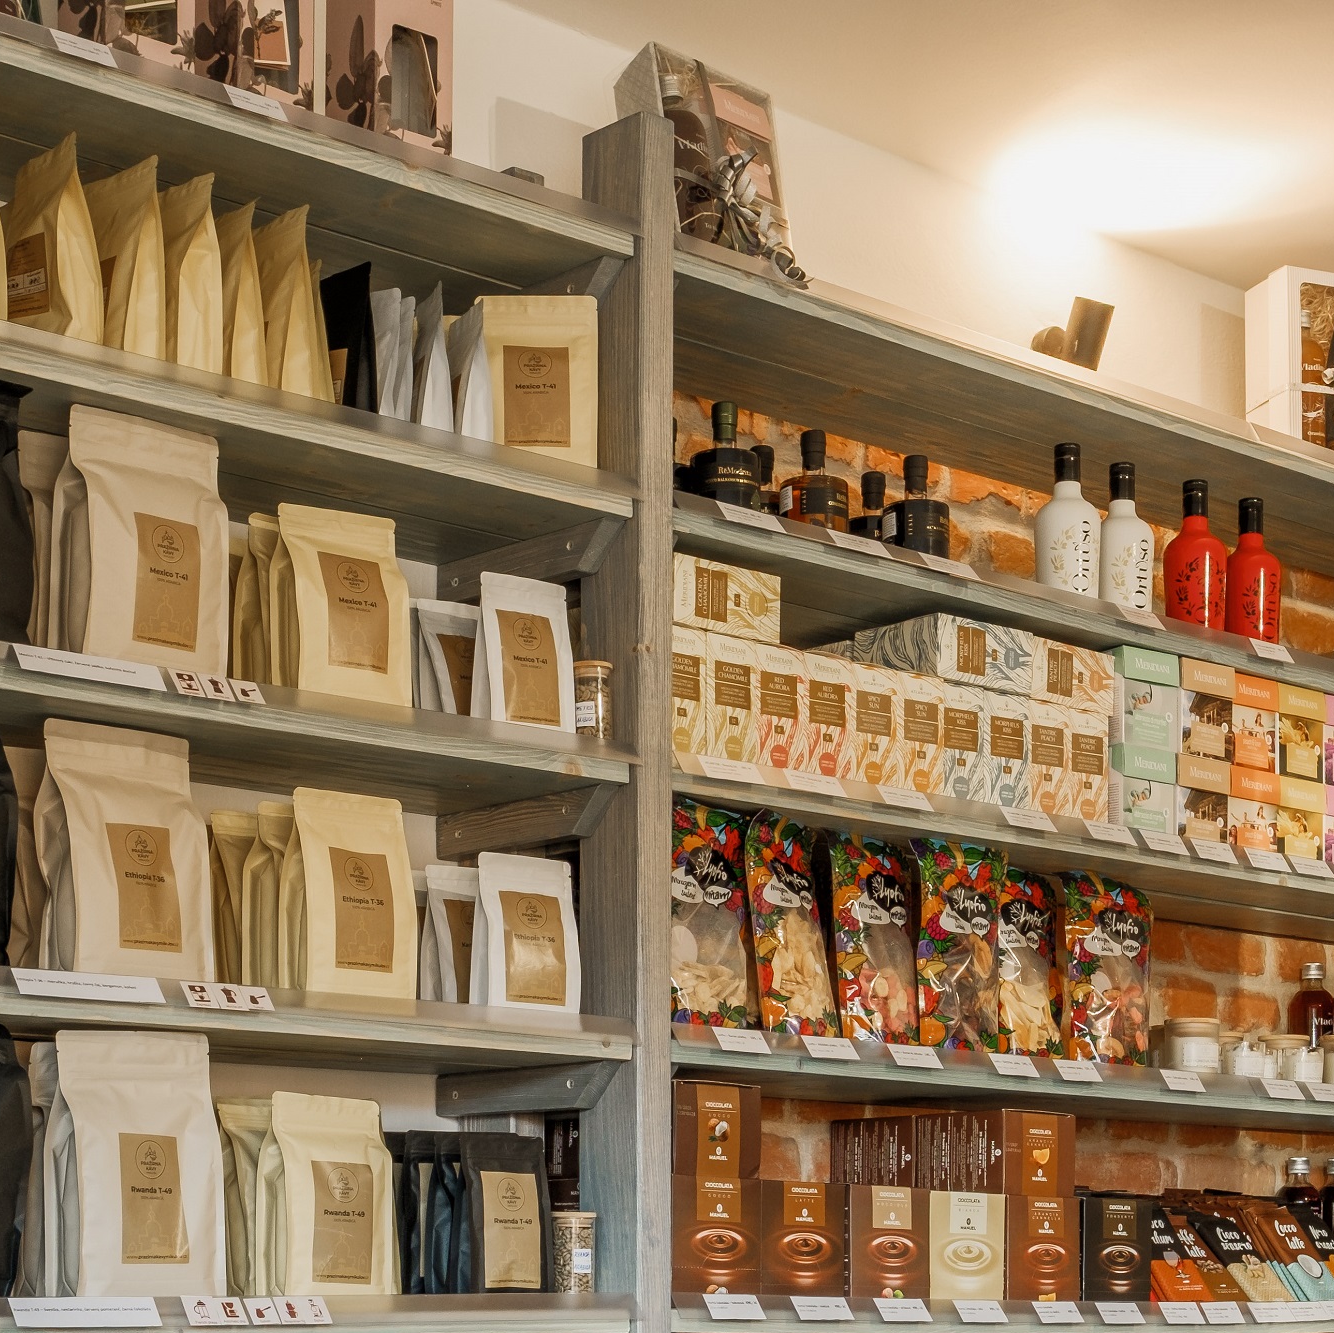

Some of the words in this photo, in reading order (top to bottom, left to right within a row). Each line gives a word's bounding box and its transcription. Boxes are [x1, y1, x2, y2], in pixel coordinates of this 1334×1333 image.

[150, 567, 174, 577] Mexico
[338, 597, 362, 606] Mexico
[723, 665, 744, 675] GOLDEN
[1135, 657, 1170, 674] MERIDIANI
[774, 676, 784, 684] RED
[1194, 671, 1227, 686] MERIDIANI
[769, 682, 790, 692] AURORA
[1239, 684, 1270, 699] MERIDIANI
[125, 871, 151, 881] Ethiopia
[343, 896, 369, 906] Ethiopia
[131, 1186, 157, 1194] Rwanda
